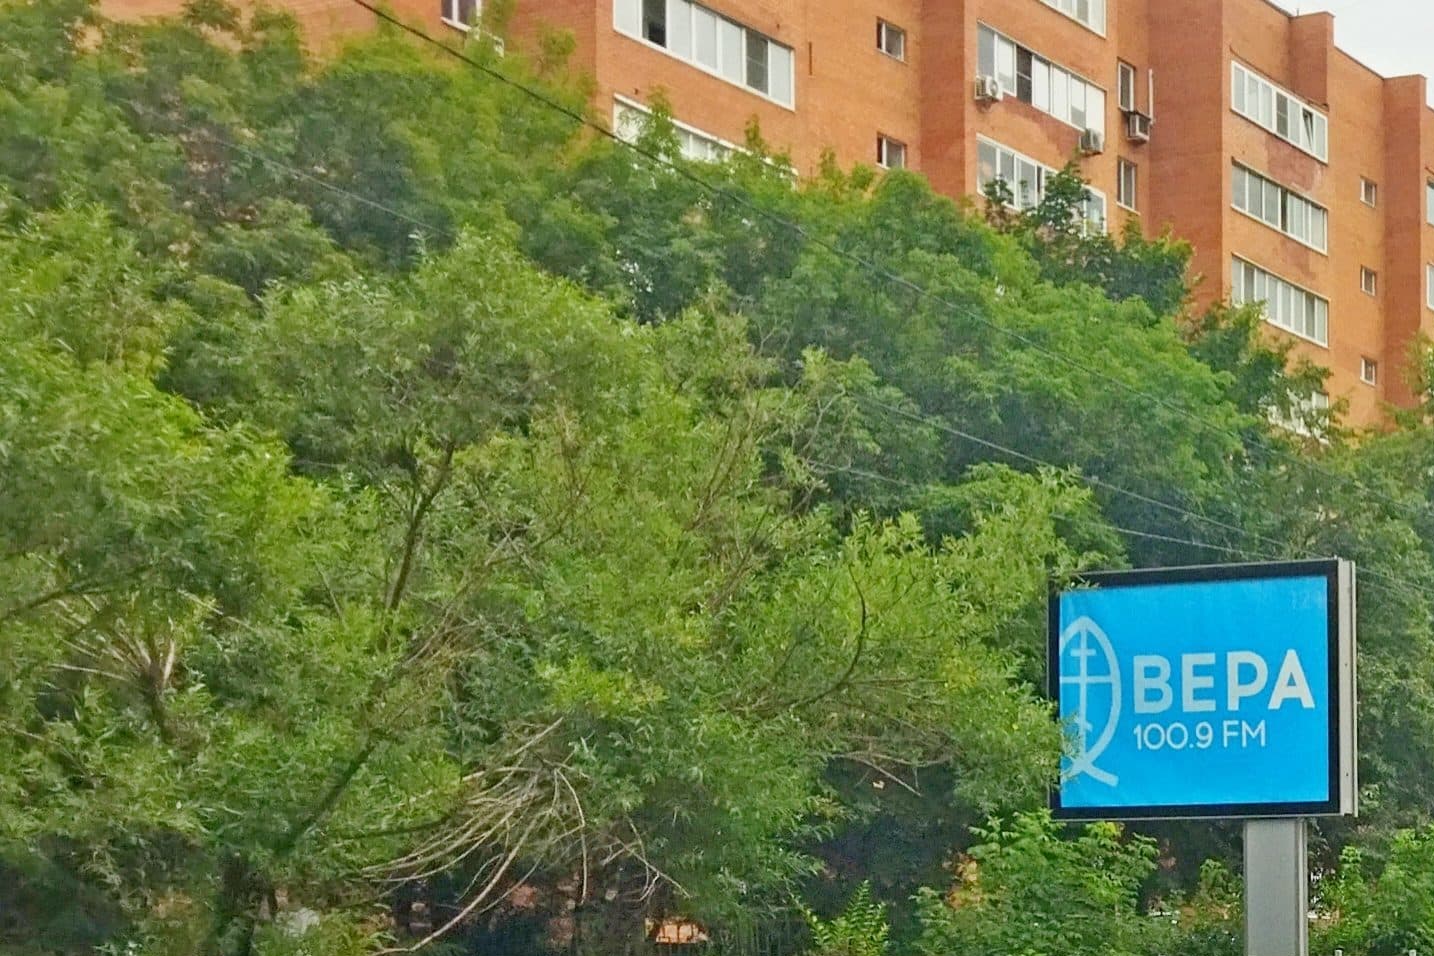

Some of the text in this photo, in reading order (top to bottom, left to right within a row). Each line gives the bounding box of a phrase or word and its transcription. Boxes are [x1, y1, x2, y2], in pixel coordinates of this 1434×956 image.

[1133, 649, 1315, 714] ВЕРА
[1133, 719, 1266, 750] 100.9 FM
